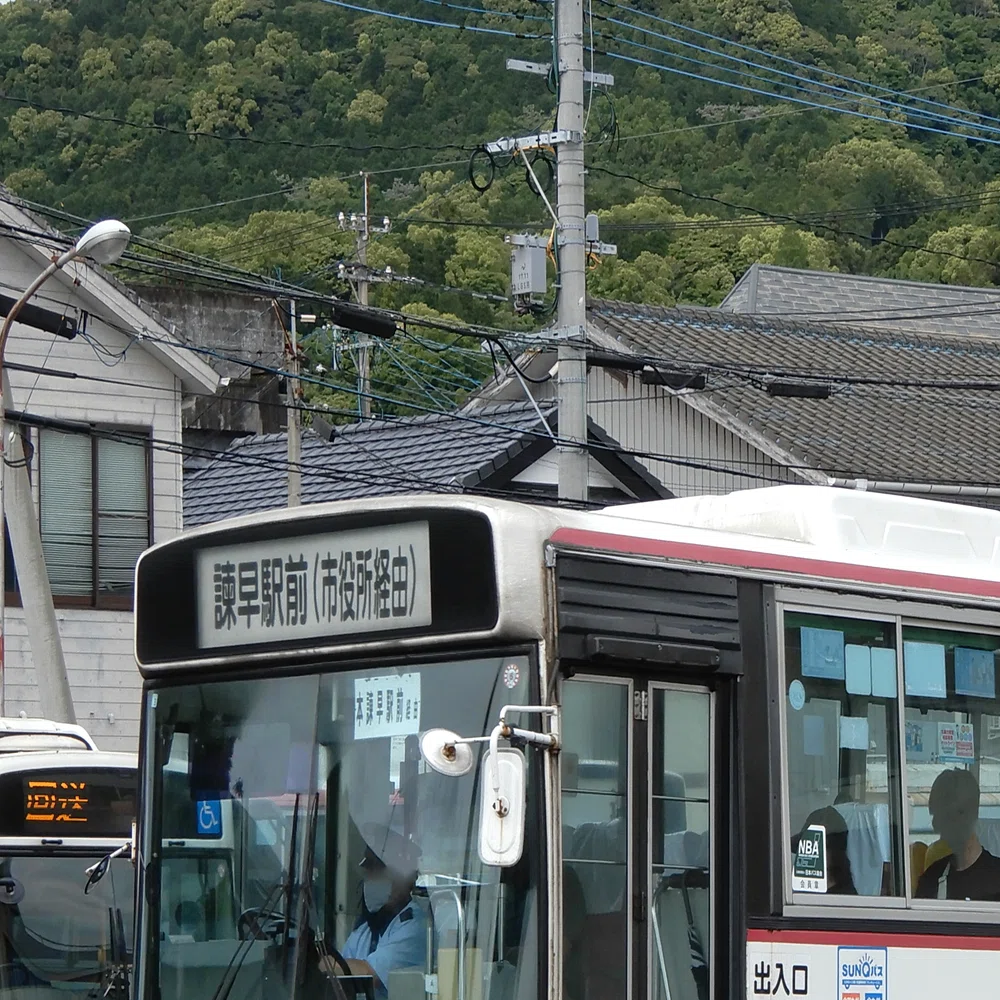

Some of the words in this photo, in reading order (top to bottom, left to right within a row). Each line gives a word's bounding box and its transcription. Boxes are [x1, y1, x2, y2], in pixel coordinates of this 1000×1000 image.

[798, 839, 819, 855] NBA
[842, 961, 883, 977] SUNQパス
[754, 961, 808, 995] 出入口
